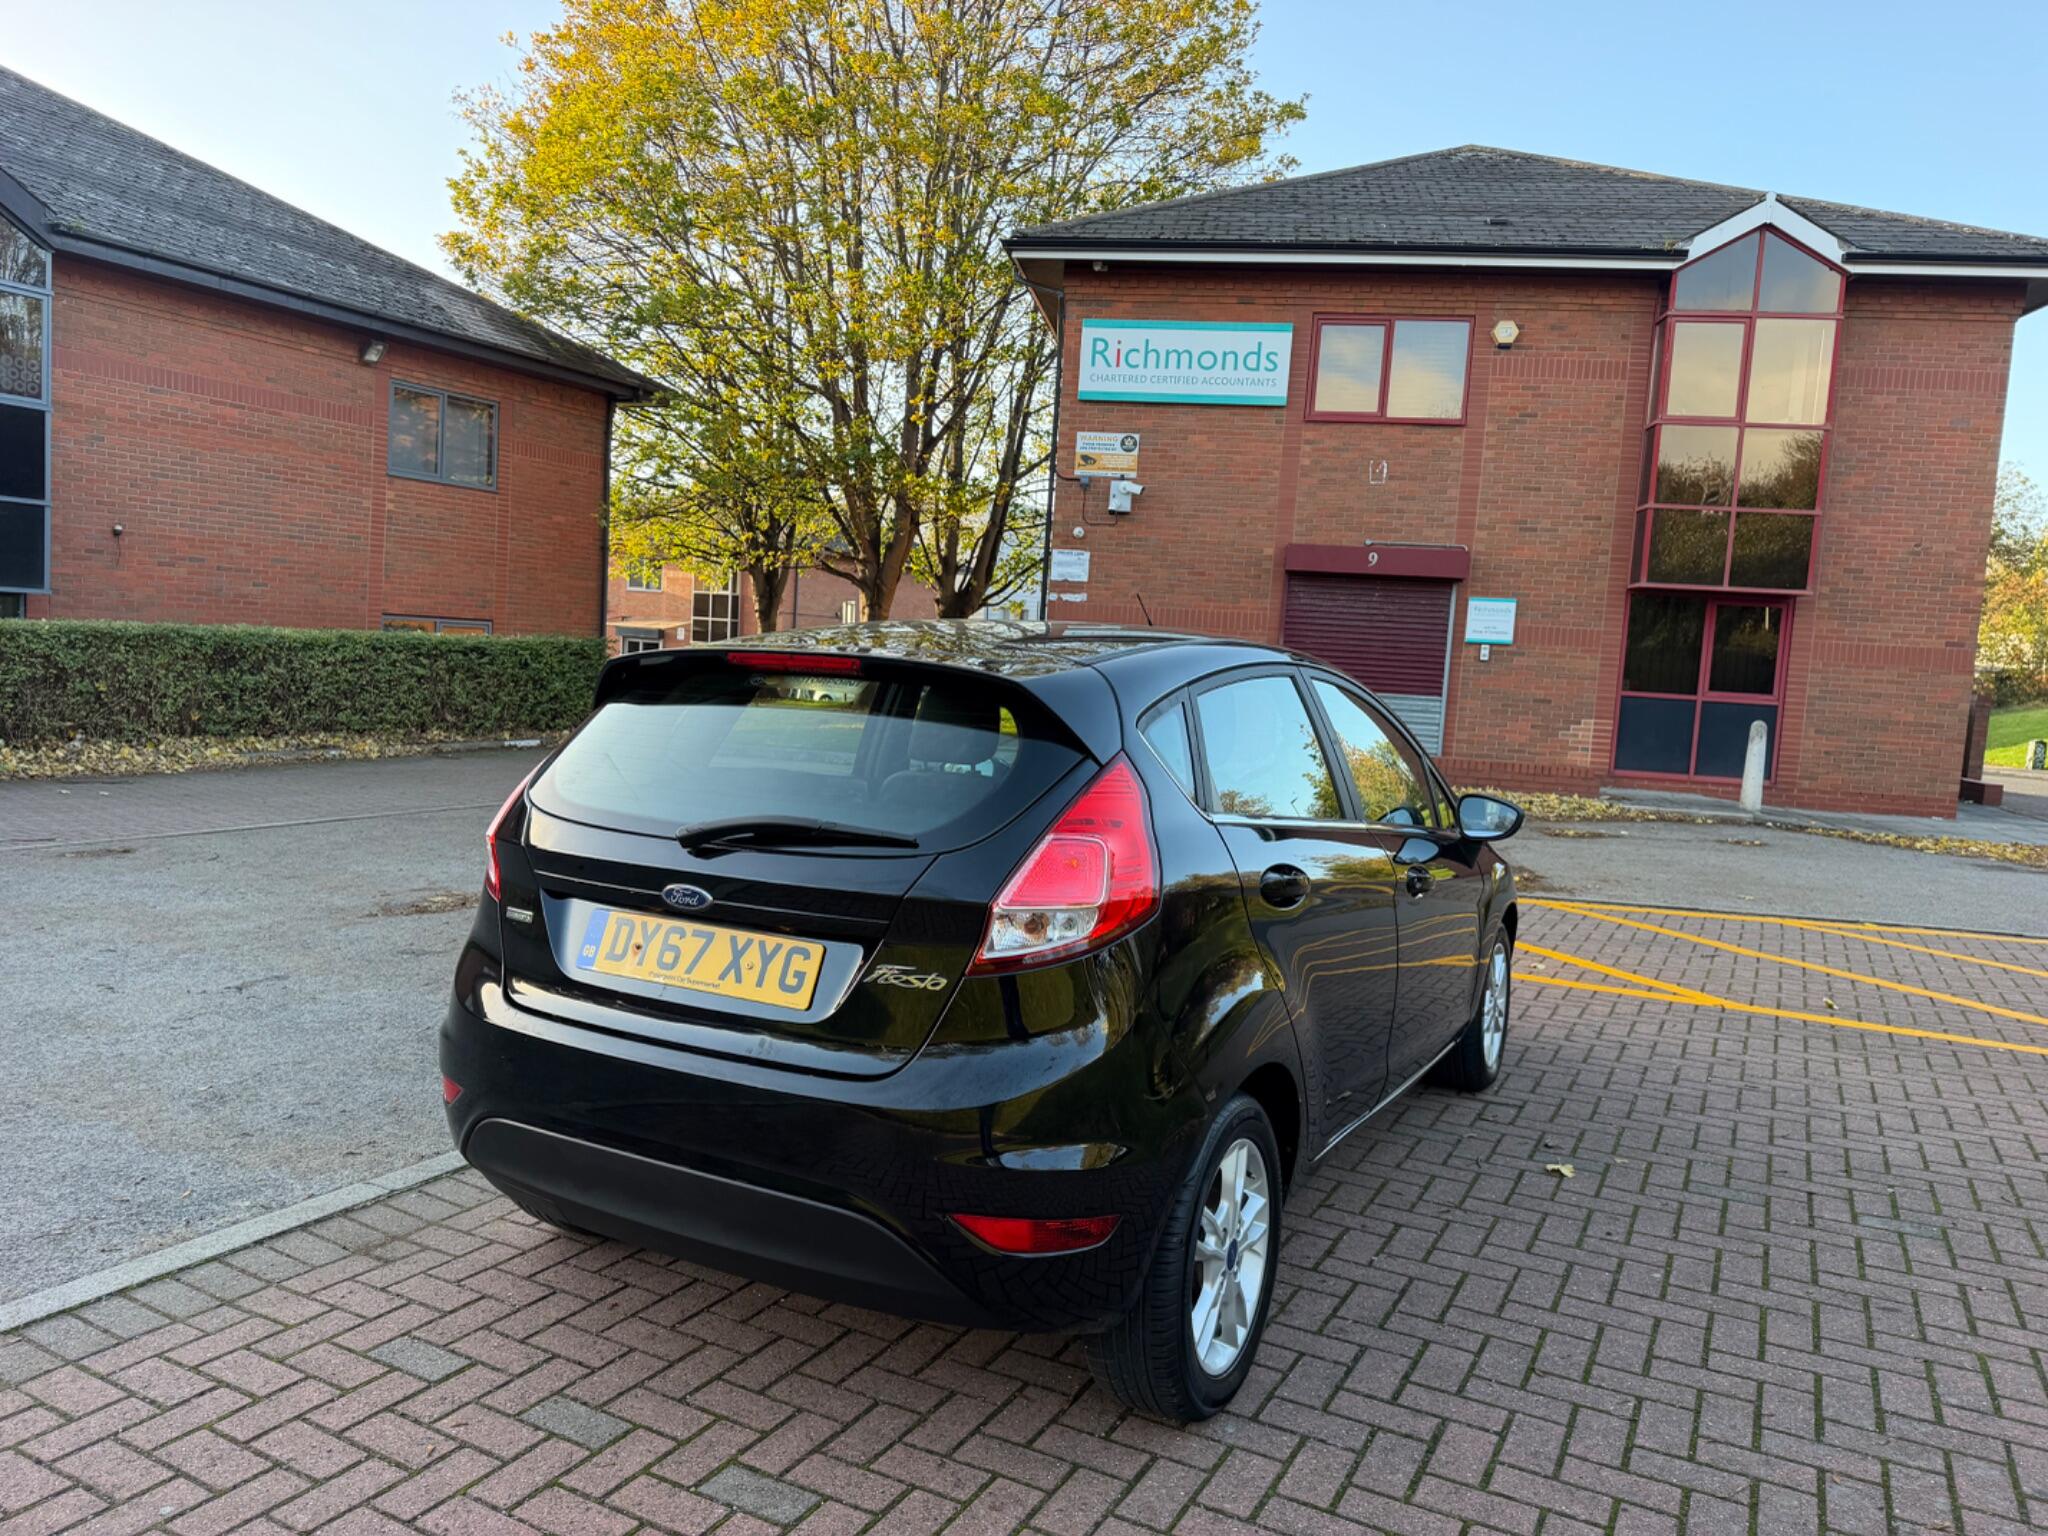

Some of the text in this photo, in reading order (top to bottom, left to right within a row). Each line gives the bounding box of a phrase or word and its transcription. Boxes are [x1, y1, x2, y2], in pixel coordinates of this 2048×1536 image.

[1090, 337, 1279, 372] Richmonds
[1089, 373, 1278, 388] CHARTERED CERTIFIED ACCOUNTANTS
[1367, 552, 1378, 567] 9
[670, 888, 700, 905] Ford
[583, 945, 596, 959] GB
[605, 916, 811, 994] DY67 XYG
[863, 964, 947, 990] Fiesta
